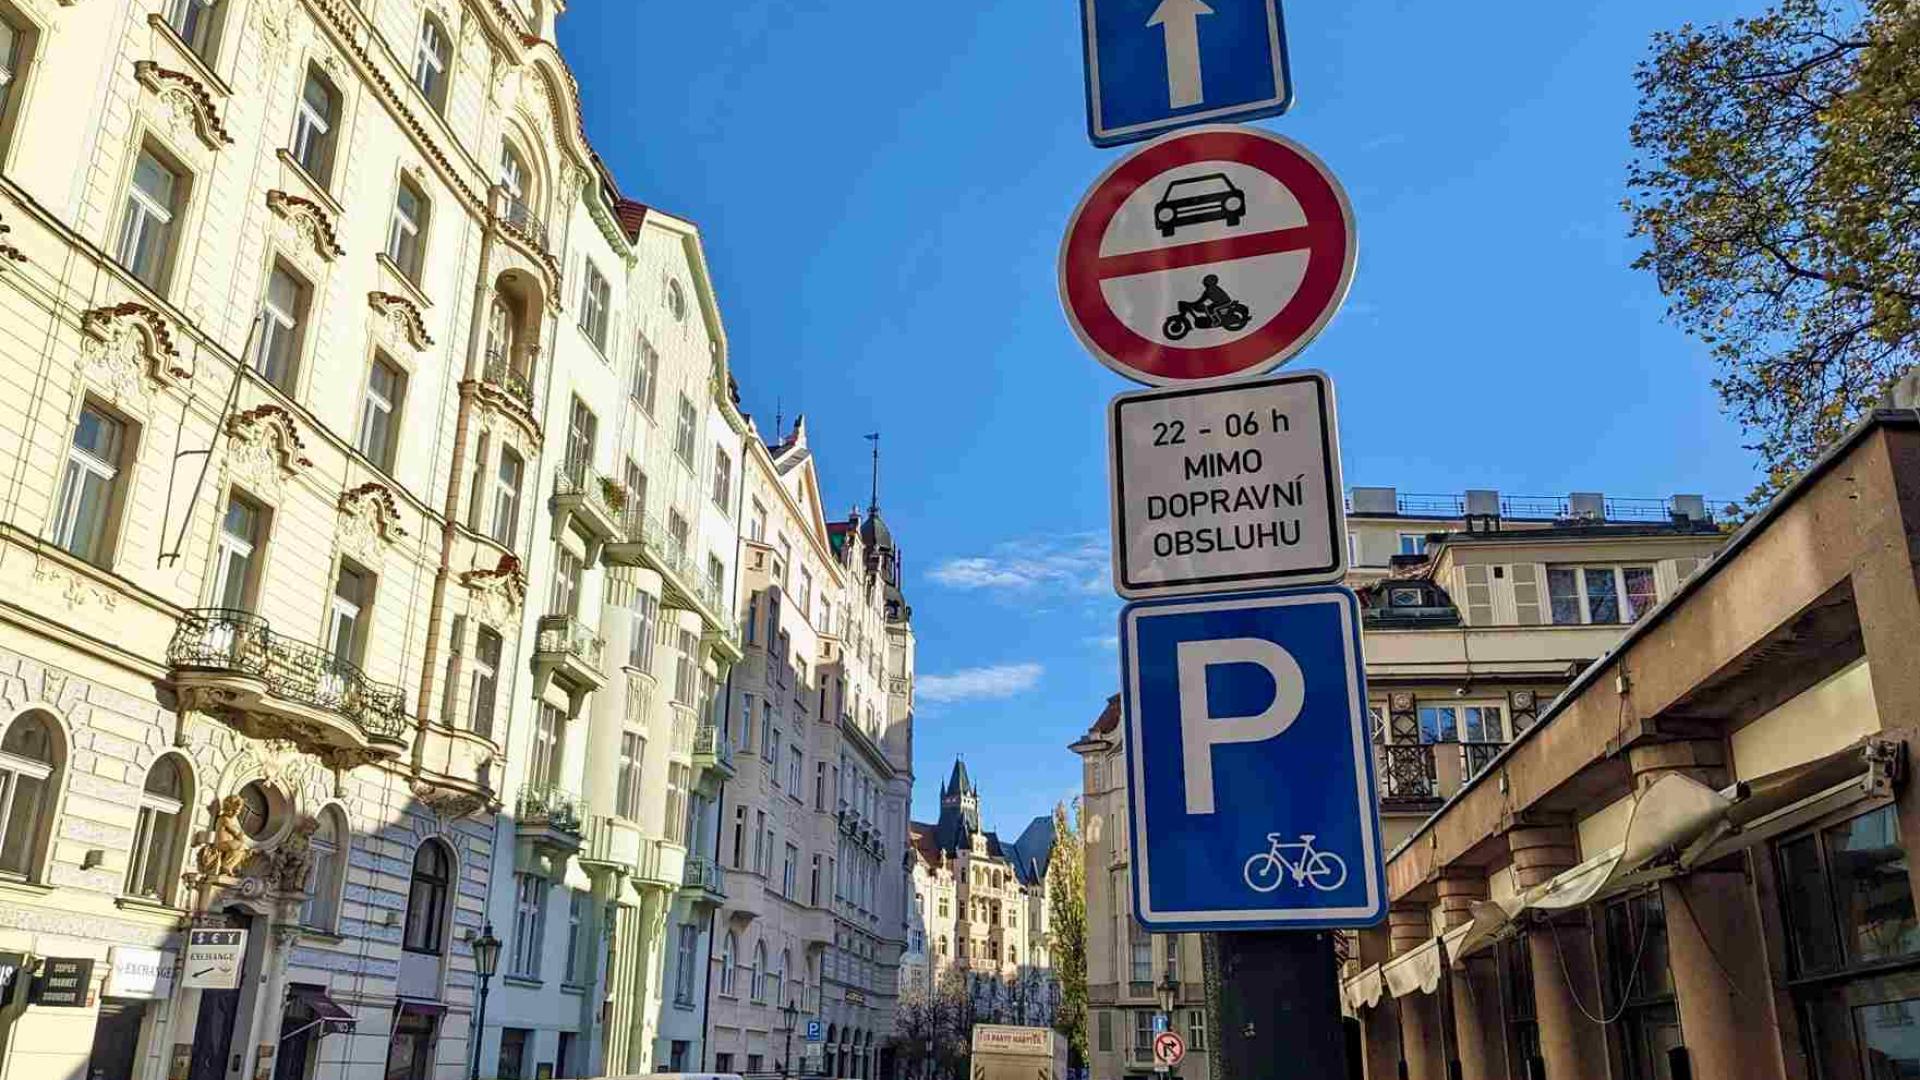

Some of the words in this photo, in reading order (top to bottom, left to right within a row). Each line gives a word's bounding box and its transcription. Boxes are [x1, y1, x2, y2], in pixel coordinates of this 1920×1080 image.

[1153, 420, 1185, 447] 22
[1225, 411, 1259, 438] 06
[1271, 408, 1289, 432] h
[1184, 449, 1262, 480] MIMO
[1147, 474, 1305, 520] DOPRAVNÍ
[1153, 519, 1300, 557] OBSLUHU
[1177, 637, 1305, 815] P
[191, 953, 234, 961] EXCHANGE
[809, 1022, 819, 1035] P
